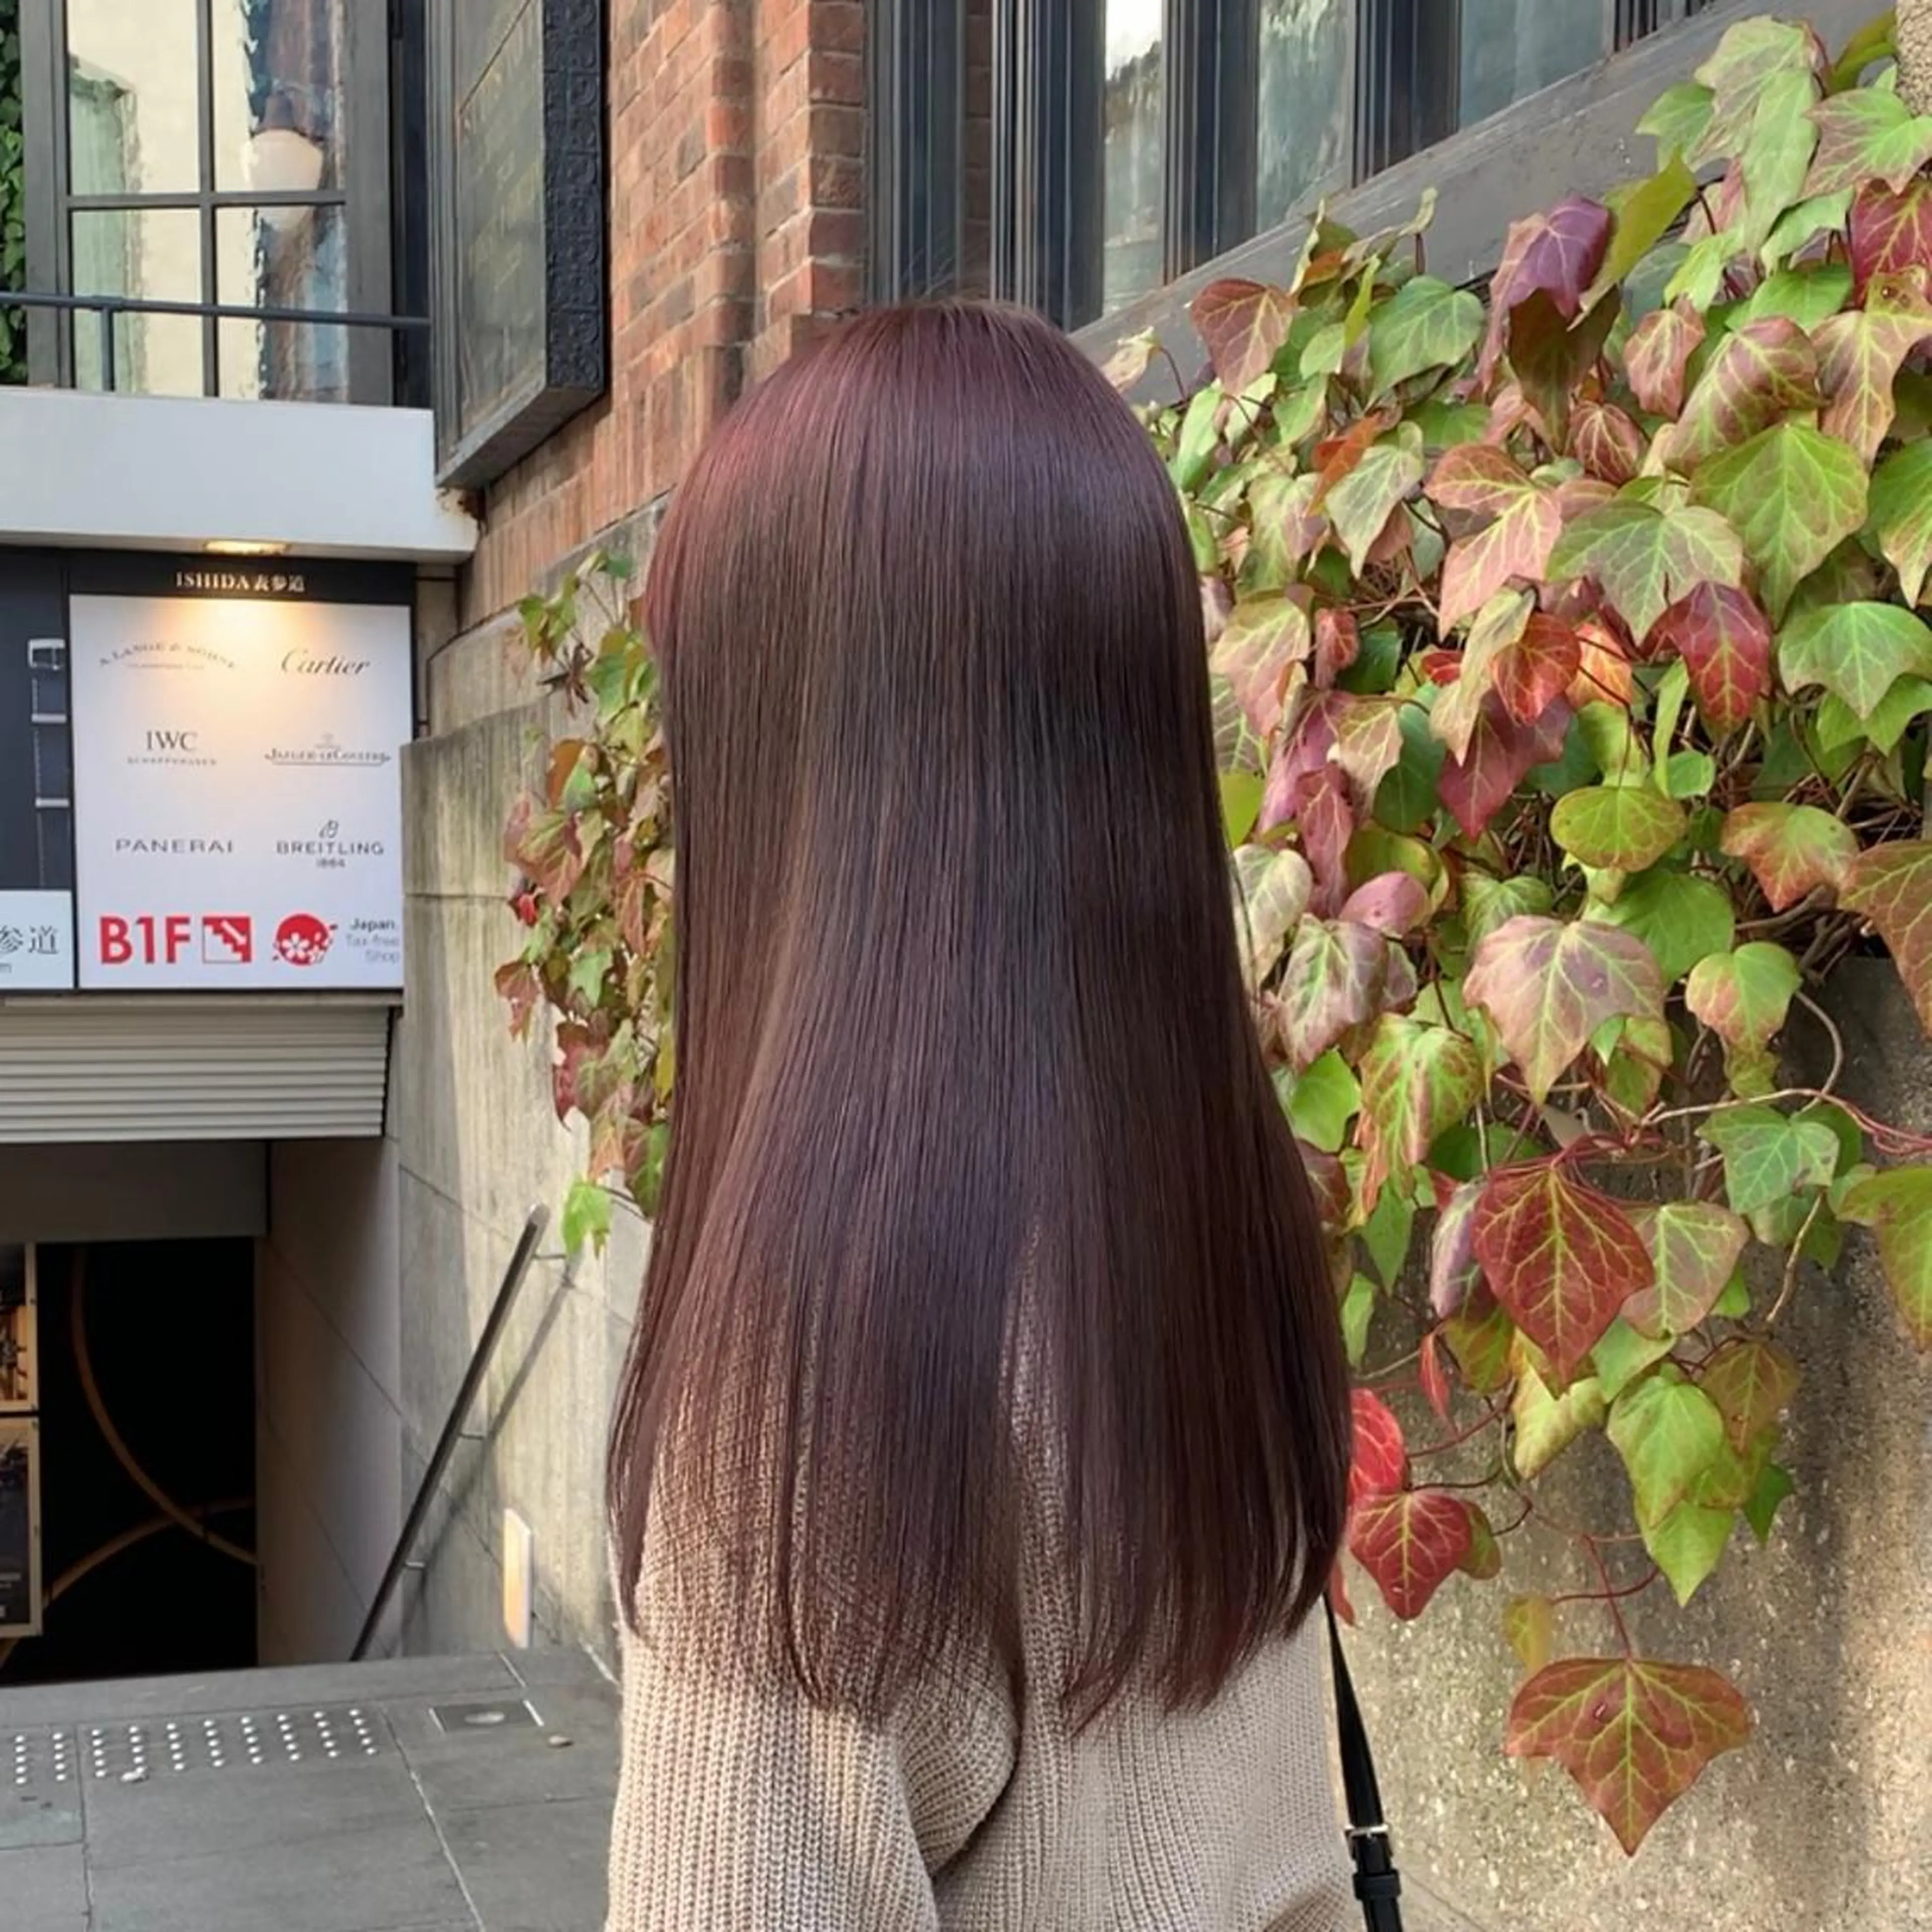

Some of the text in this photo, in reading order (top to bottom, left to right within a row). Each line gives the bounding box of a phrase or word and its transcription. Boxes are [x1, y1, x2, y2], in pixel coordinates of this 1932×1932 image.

[176, 571, 250, 591] ISHIDA
[281, 647, 371, 675] Cartier
[146, 731, 198, 752] IWC
[116, 839, 233, 853] PANERAI
[276, 840, 384, 855] BREITLING
[350, 917, 395, 934] Japan
[101, 916, 191, 964] B1F
